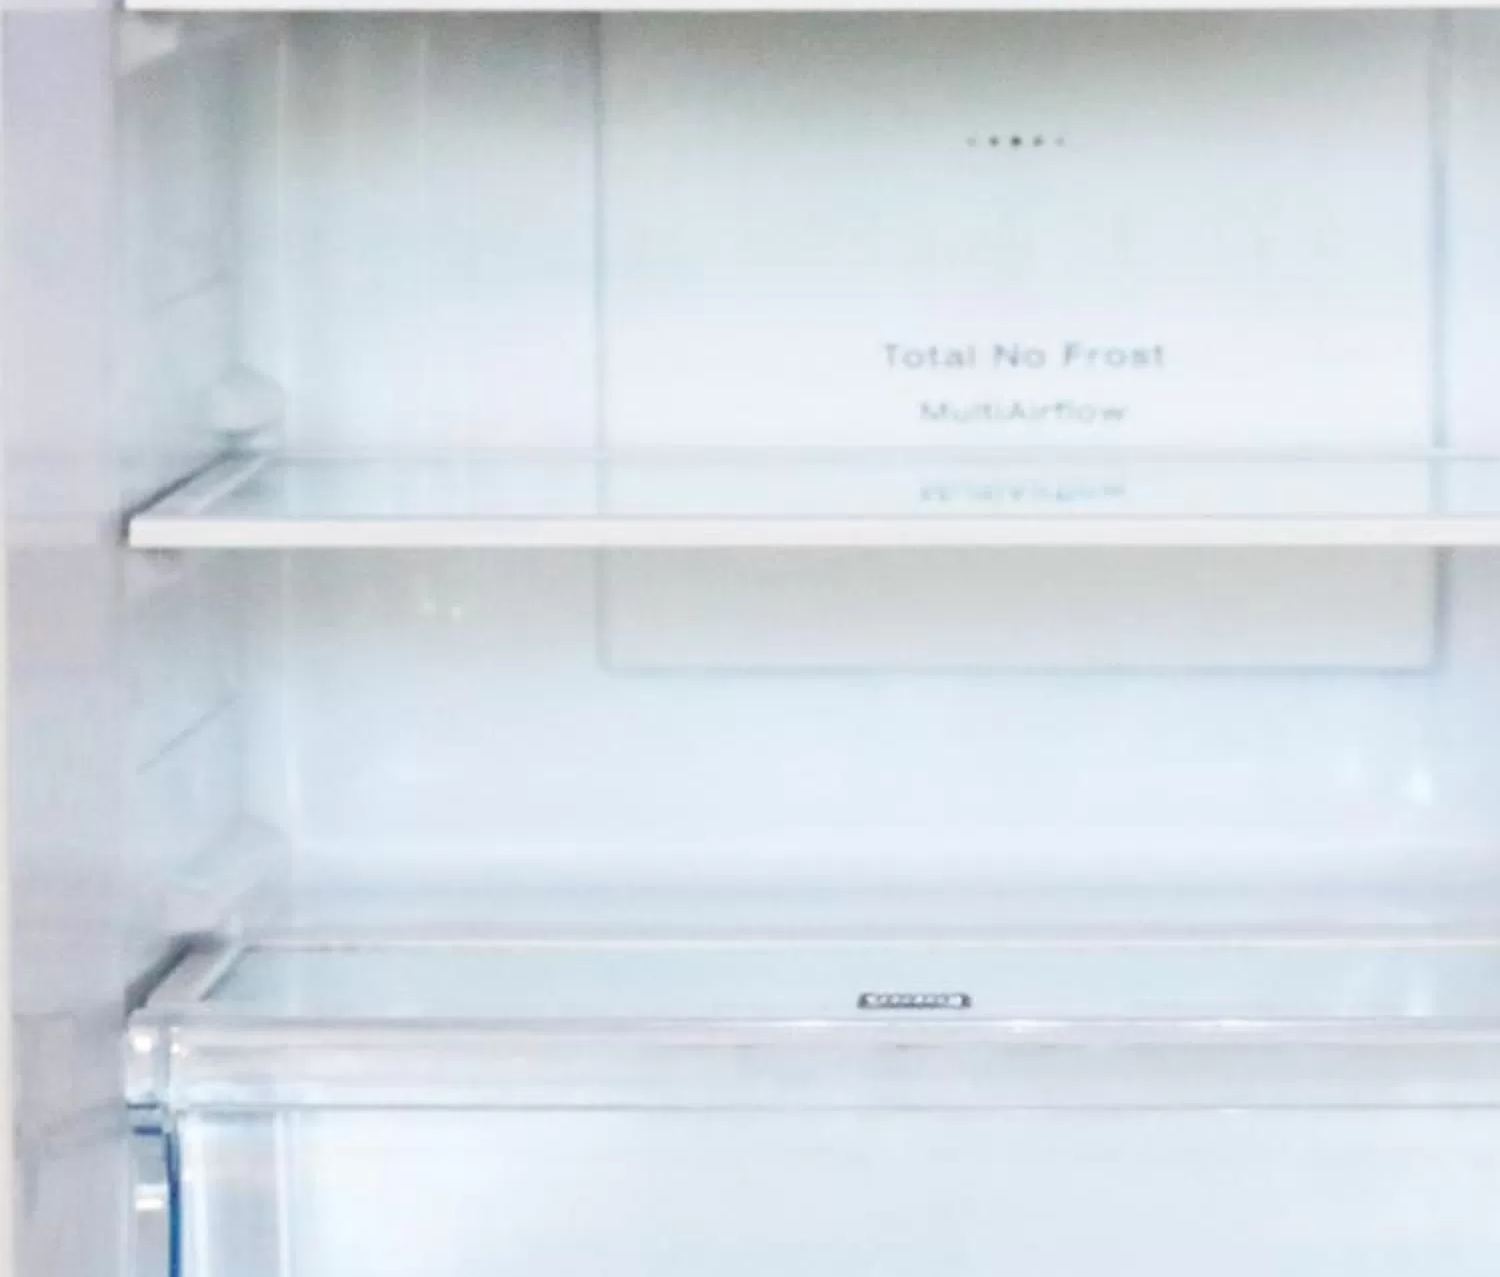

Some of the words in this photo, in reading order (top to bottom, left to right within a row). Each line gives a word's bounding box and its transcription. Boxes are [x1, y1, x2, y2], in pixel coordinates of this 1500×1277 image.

[884, 342, 977, 369] Total
[992, 342, 1047, 369] No
[1062, 341, 1166, 369] Frost
